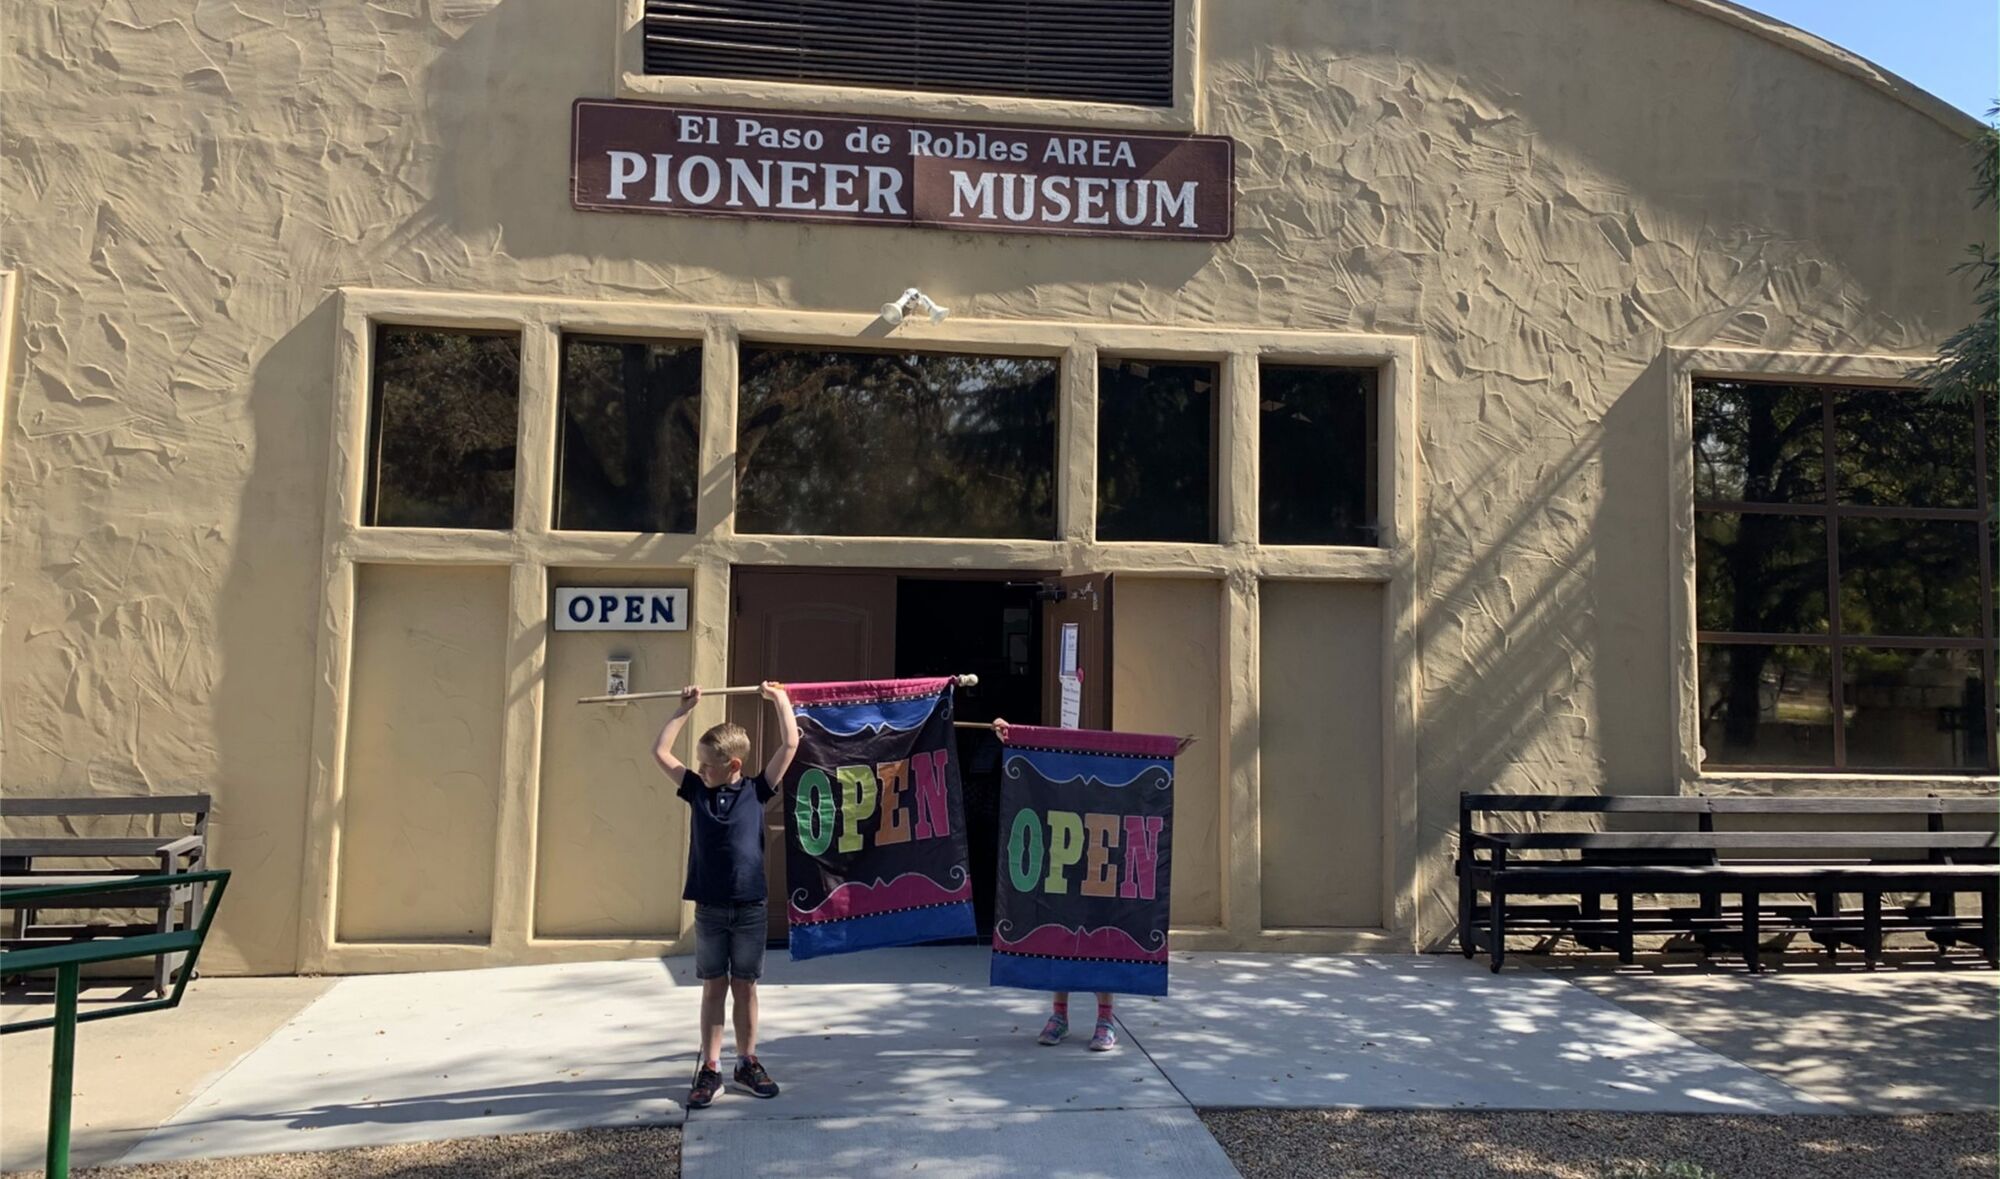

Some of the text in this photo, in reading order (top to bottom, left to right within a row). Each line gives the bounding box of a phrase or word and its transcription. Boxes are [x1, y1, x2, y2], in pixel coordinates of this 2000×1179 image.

[677, 115, 1137, 168] El Paso de Robles AREA
[606, 150, 1199, 228] PIONEER MUSEUM
[568, 595, 675, 623] OPEN
[795, 748, 950, 856] OPEN
[1007, 807, 1163, 899] OPEN
